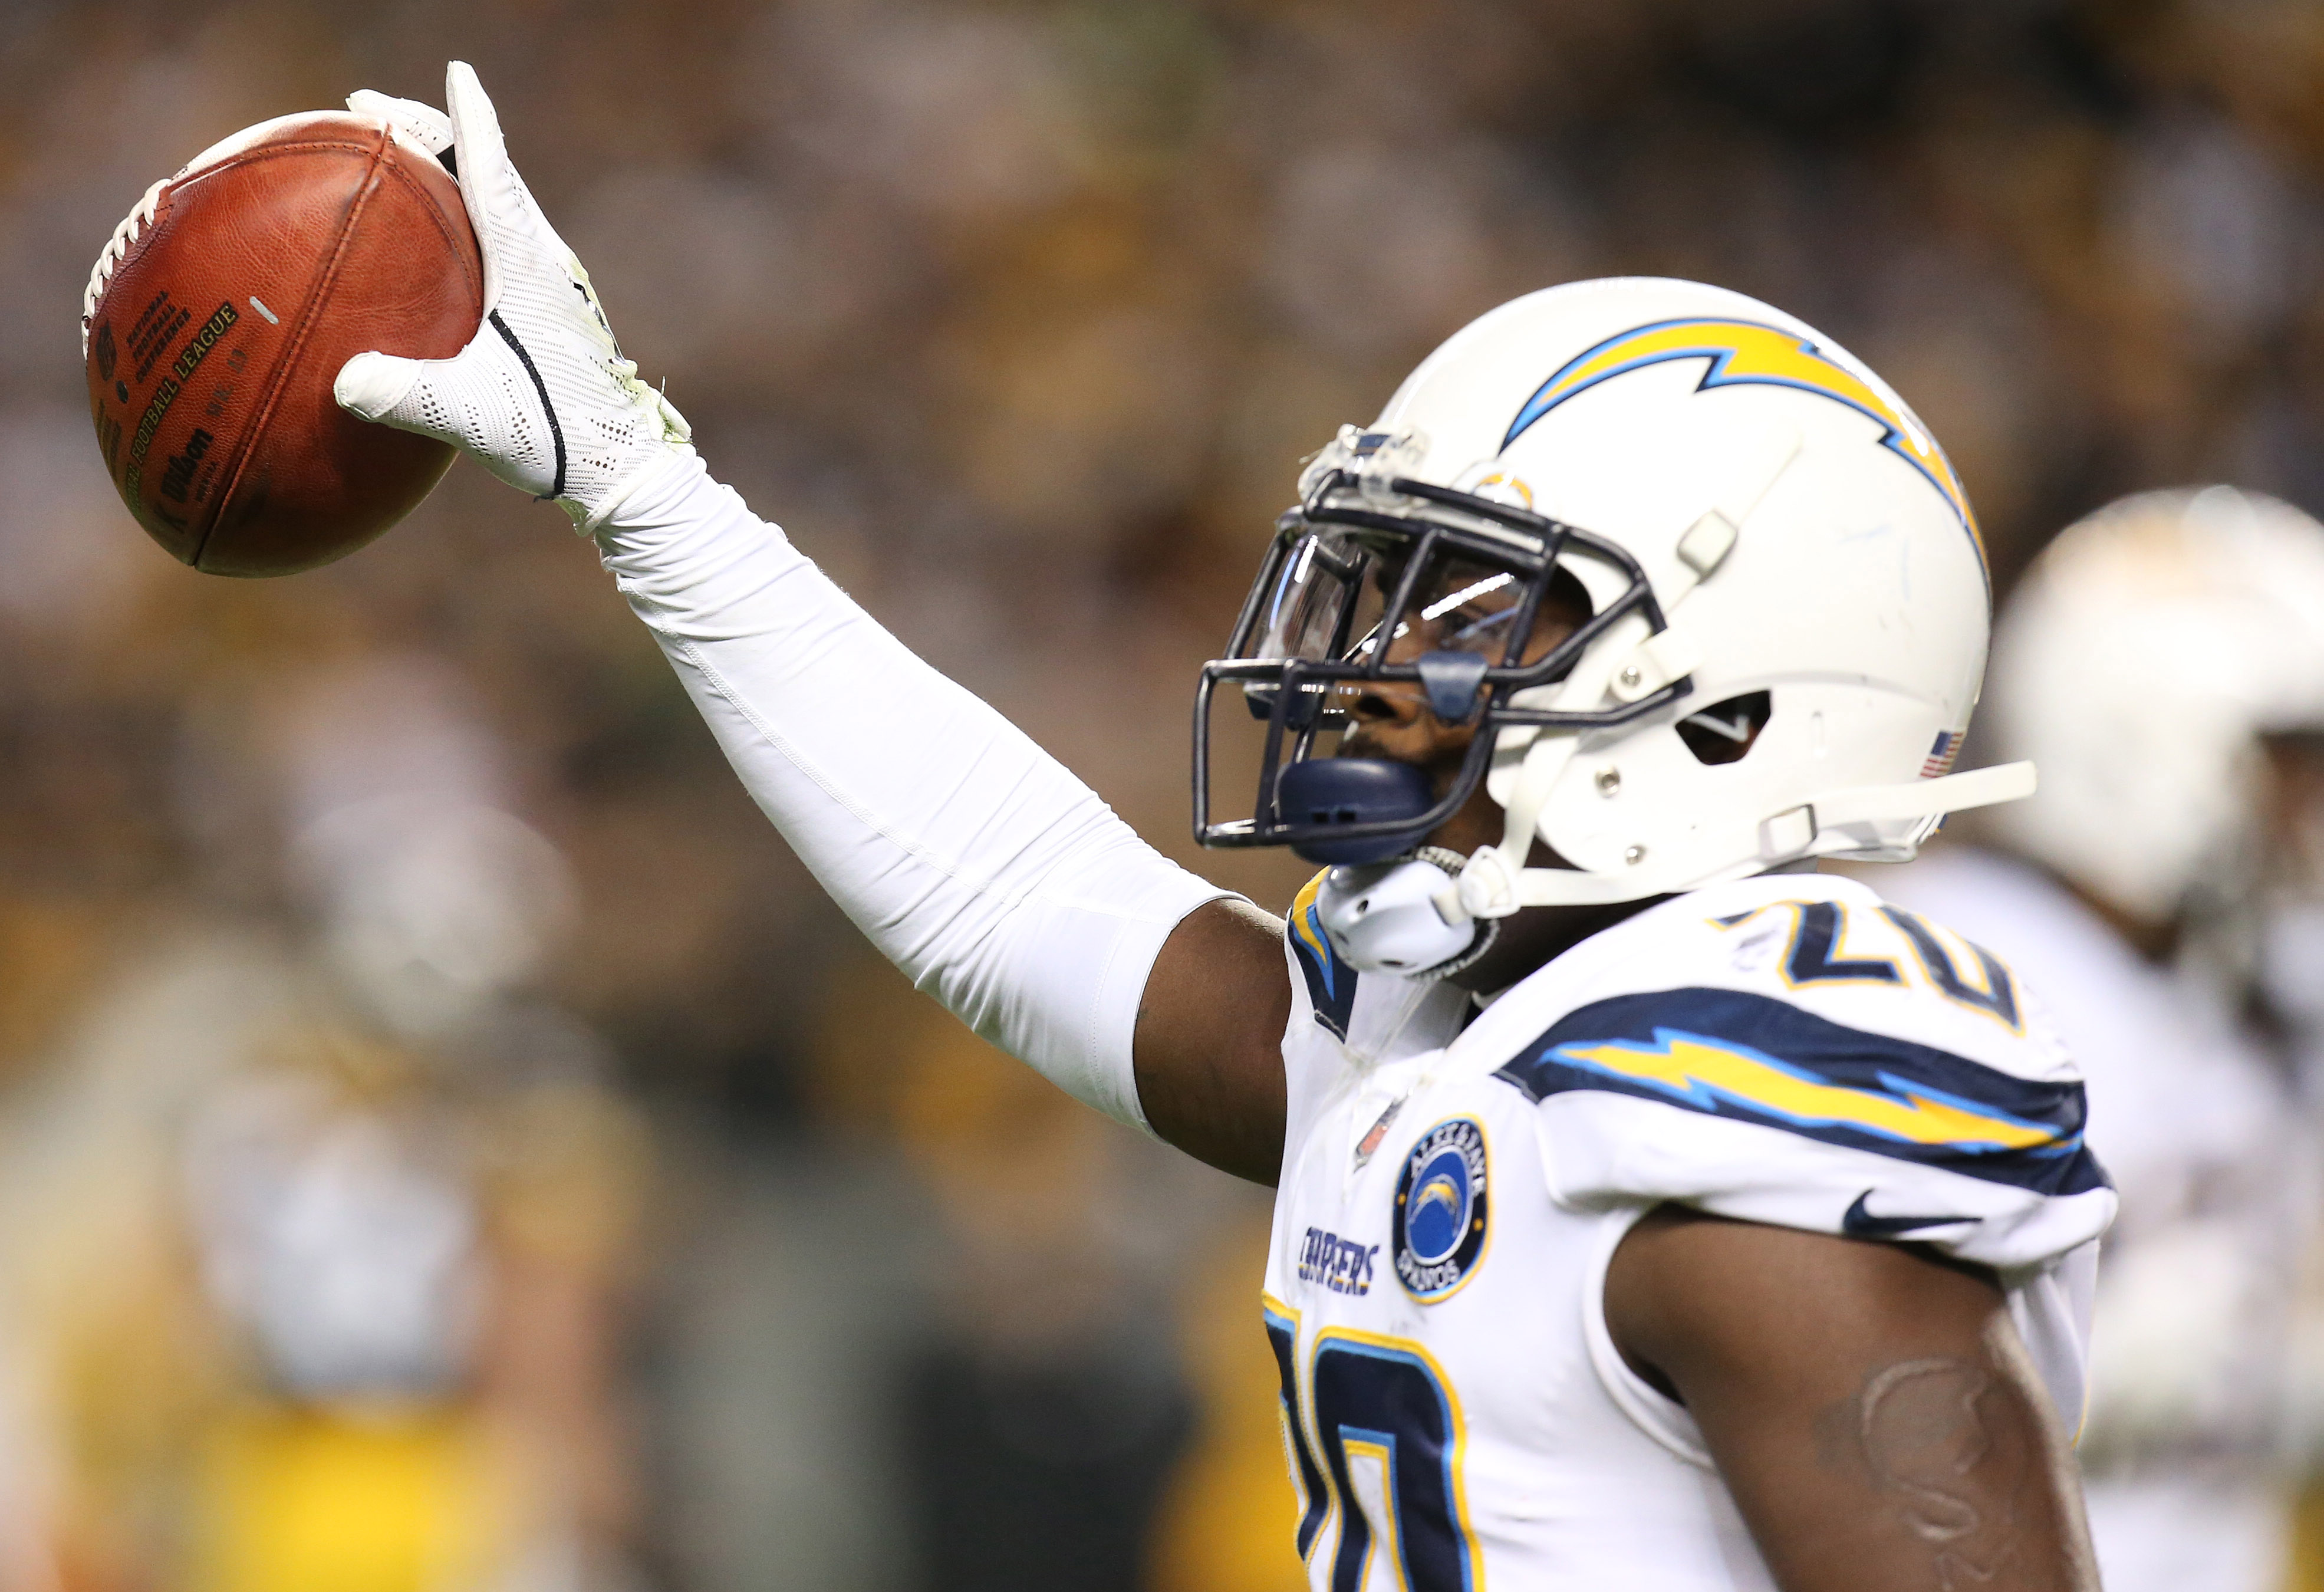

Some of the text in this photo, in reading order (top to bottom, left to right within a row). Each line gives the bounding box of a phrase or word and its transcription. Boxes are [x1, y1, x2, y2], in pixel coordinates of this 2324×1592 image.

[130, 376, 181, 465] FOOTBALL
[173, 300, 239, 380] LEAGUE
[160, 428, 214, 503] Wilson
[1705, 900, 2027, 1038] 20
[1397, 1248, 1461, 1291] SPANOS
